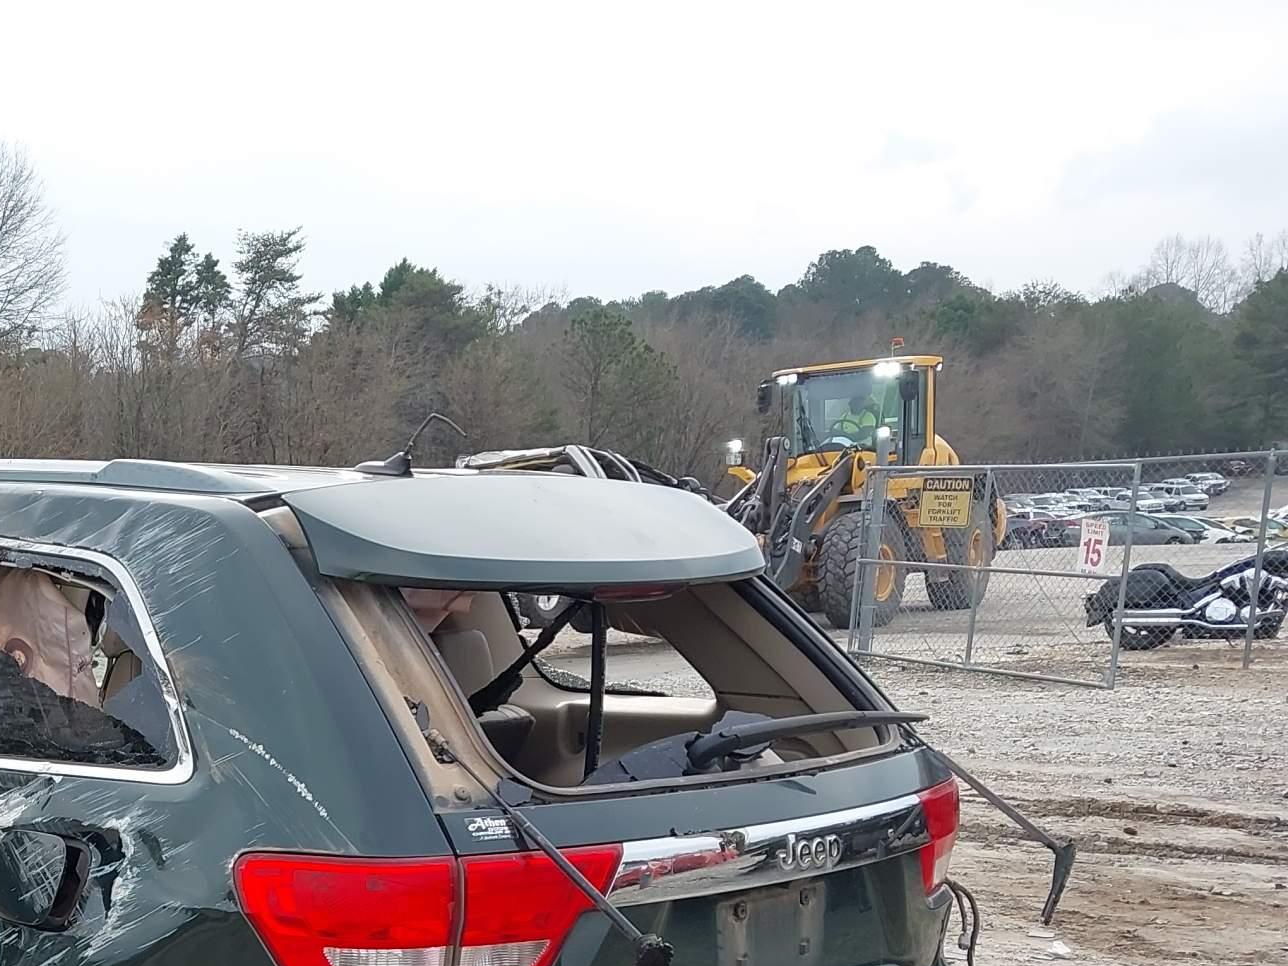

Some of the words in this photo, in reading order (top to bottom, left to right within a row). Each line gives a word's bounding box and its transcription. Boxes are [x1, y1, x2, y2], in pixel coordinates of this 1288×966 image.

[926, 479, 970, 490] CAUTION
[1085, 521, 1107, 531] SPEED
[1087, 528, 1104, 537] LIMIT
[1083, 537, 1104, 568] 15
[467, 816, 508, 832] Athen
[775, 832, 843, 872] Jeep
